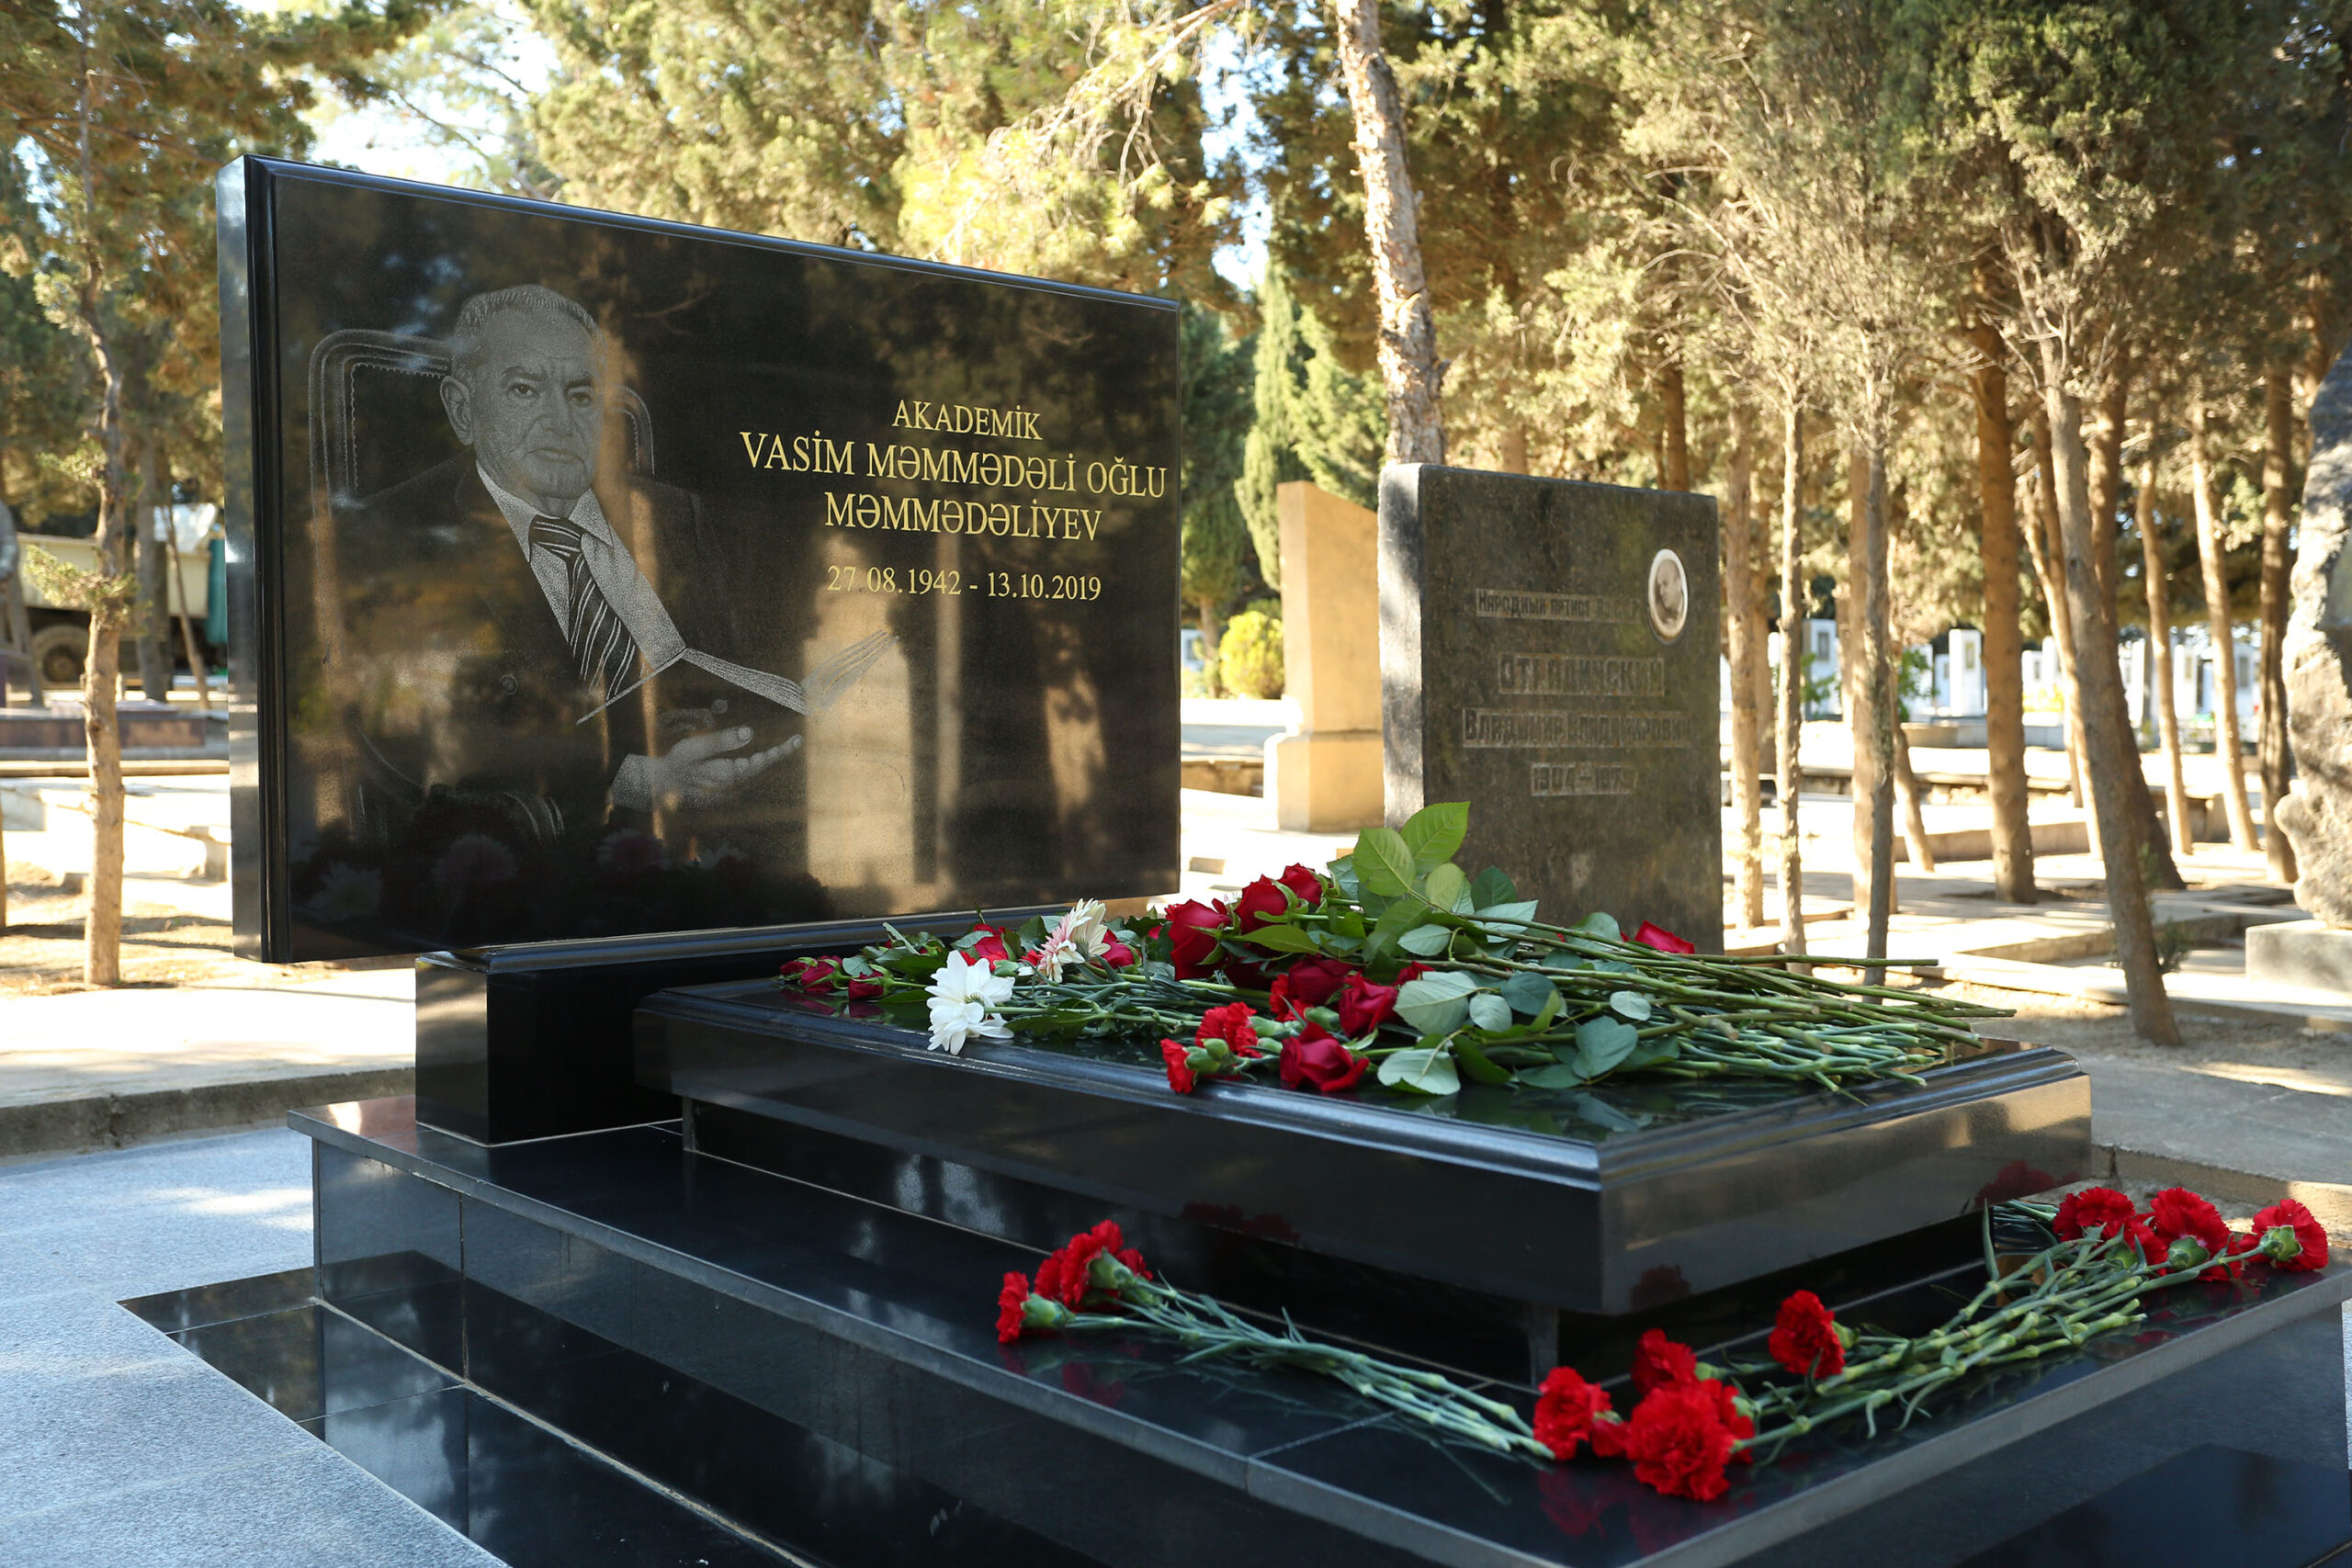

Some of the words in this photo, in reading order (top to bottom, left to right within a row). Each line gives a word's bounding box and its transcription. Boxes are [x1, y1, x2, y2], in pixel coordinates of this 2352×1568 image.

[892, 399, 1043, 440] AKADEMİK
[740, 430, 854, 476] VASİM
[866, 443, 1077, 492] MƏMMƏDƏLİ
[1087, 456, 1167, 498] OĞLU
[824, 491, 1102, 541] MƏMMƏDƏLİYEV
[988, 571, 1101, 601] 13.10.2019
